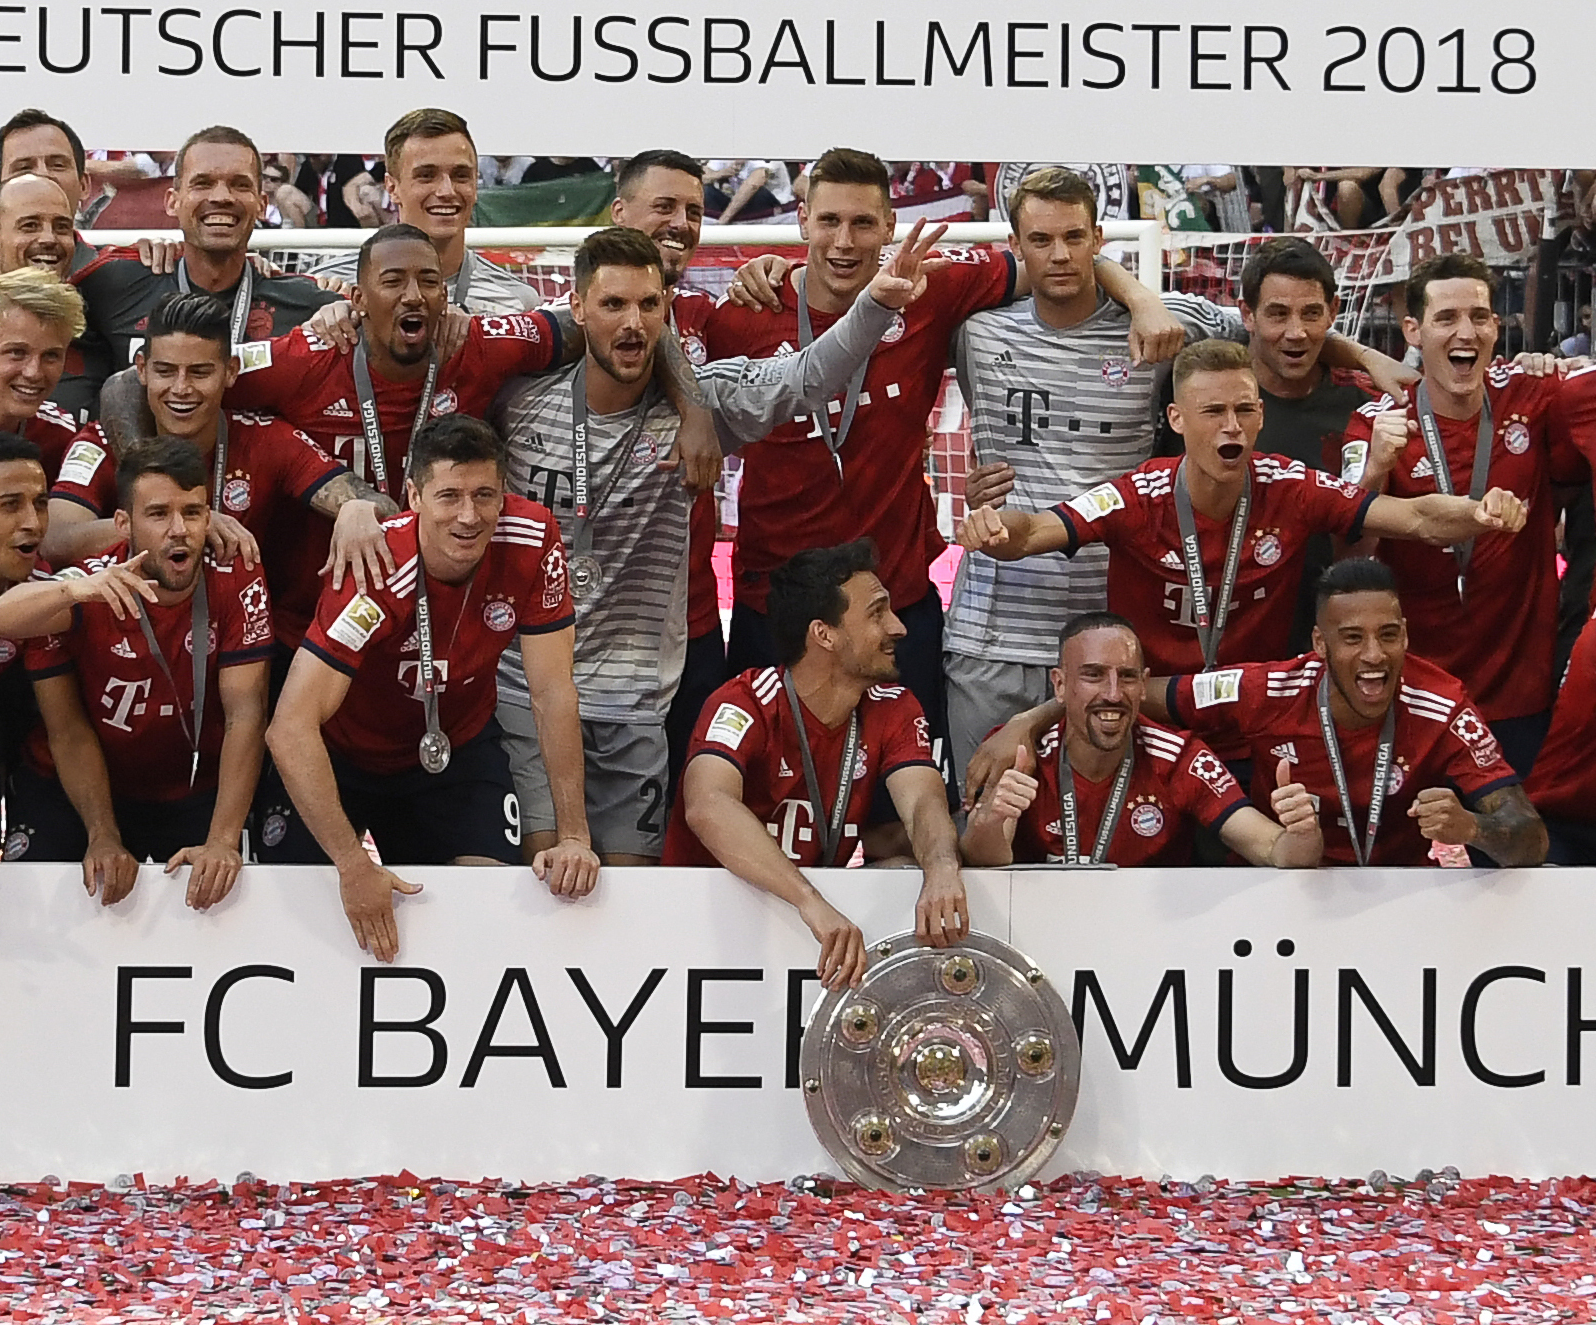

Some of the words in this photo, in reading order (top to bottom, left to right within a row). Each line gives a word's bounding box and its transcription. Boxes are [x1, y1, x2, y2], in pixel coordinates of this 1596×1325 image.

[479, 14, 1292, 91] FUSSBALLMEISTER
[1322, 25, 1538, 95] 2018
[1406, 223, 1485, 267] BEI
[362, 399, 386, 481] BUNDESLIGA
[575, 423, 588, 505] BUNDESLIGA
[1184, 534, 1206, 614] BUNDESLIGA
[418, 595, 433, 681] BUNDESLIGA
[503, 793, 522, 847] 9
[637, 778, 664, 834] 2
[1369, 742, 1391, 824] BUNDESLIGA
[1063, 791, 1078, 864] UNDESLIGA
[113, 963, 297, 1090] FC
[356, 965, 824, 1090] BAYE
